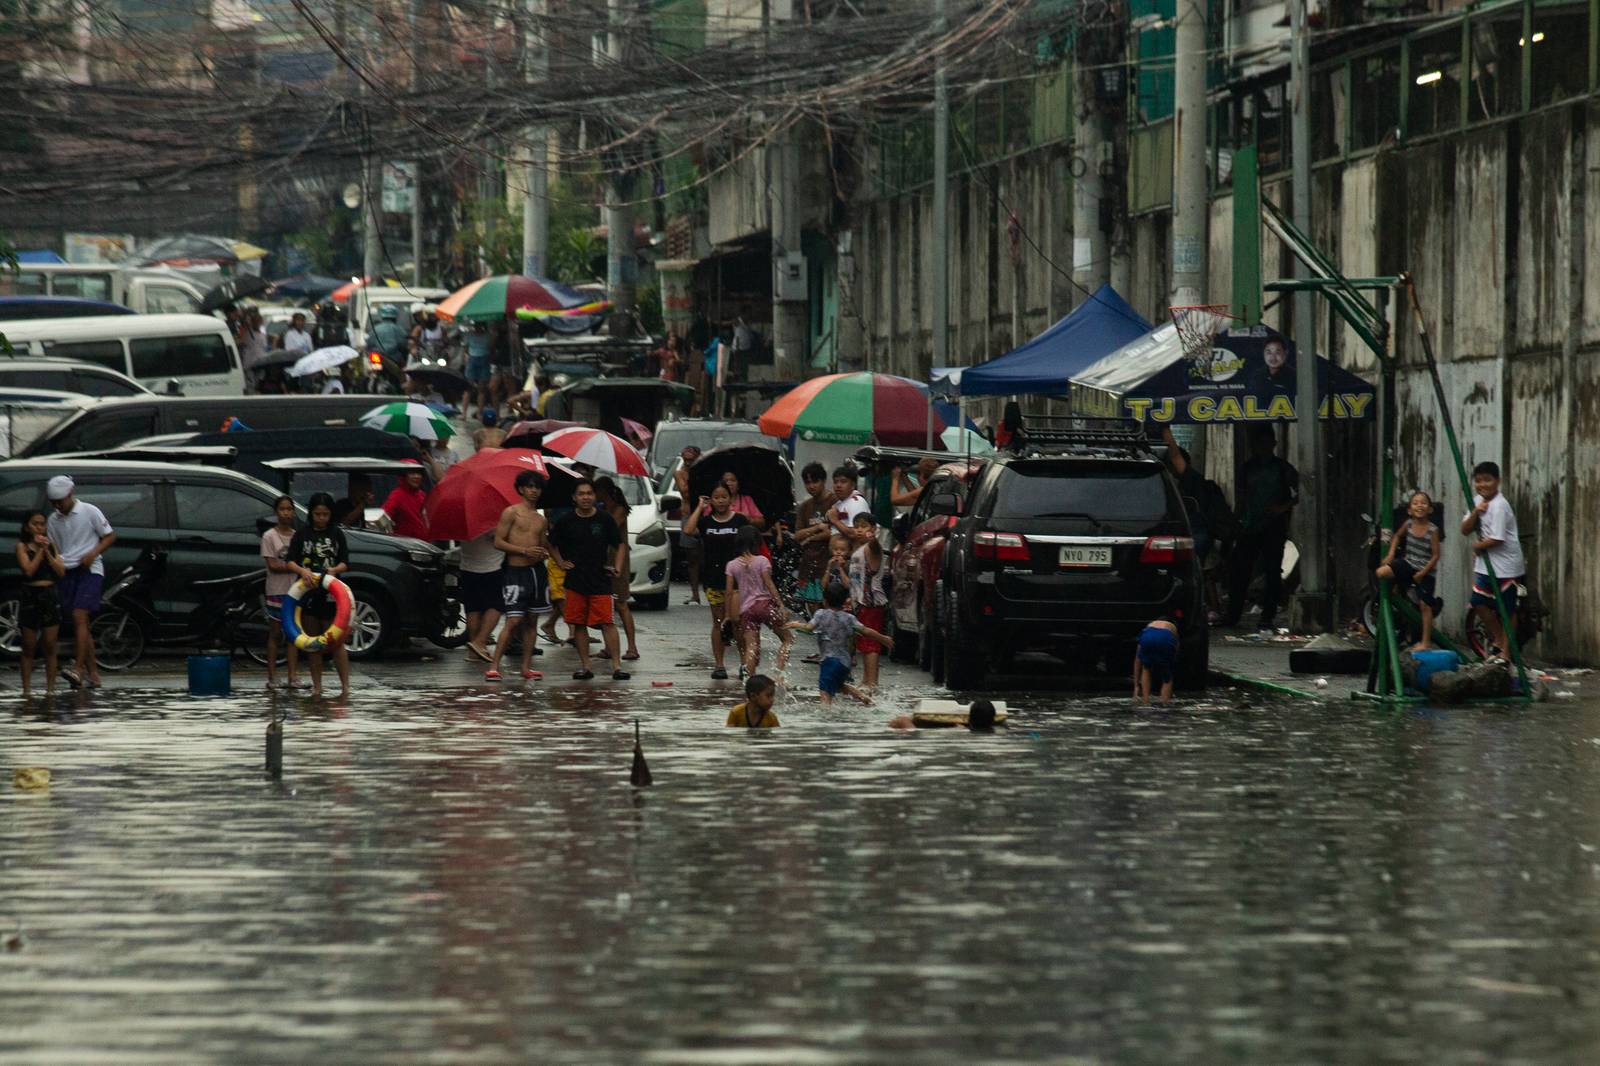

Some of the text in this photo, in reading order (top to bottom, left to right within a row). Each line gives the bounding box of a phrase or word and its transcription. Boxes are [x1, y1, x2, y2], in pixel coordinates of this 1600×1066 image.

[1124, 397, 1176, 423] TJ
[1187, 393, 1373, 421] CALAAY
[706, 527, 739, 535] FUBU
[1089, 550, 1108, 562] 795
